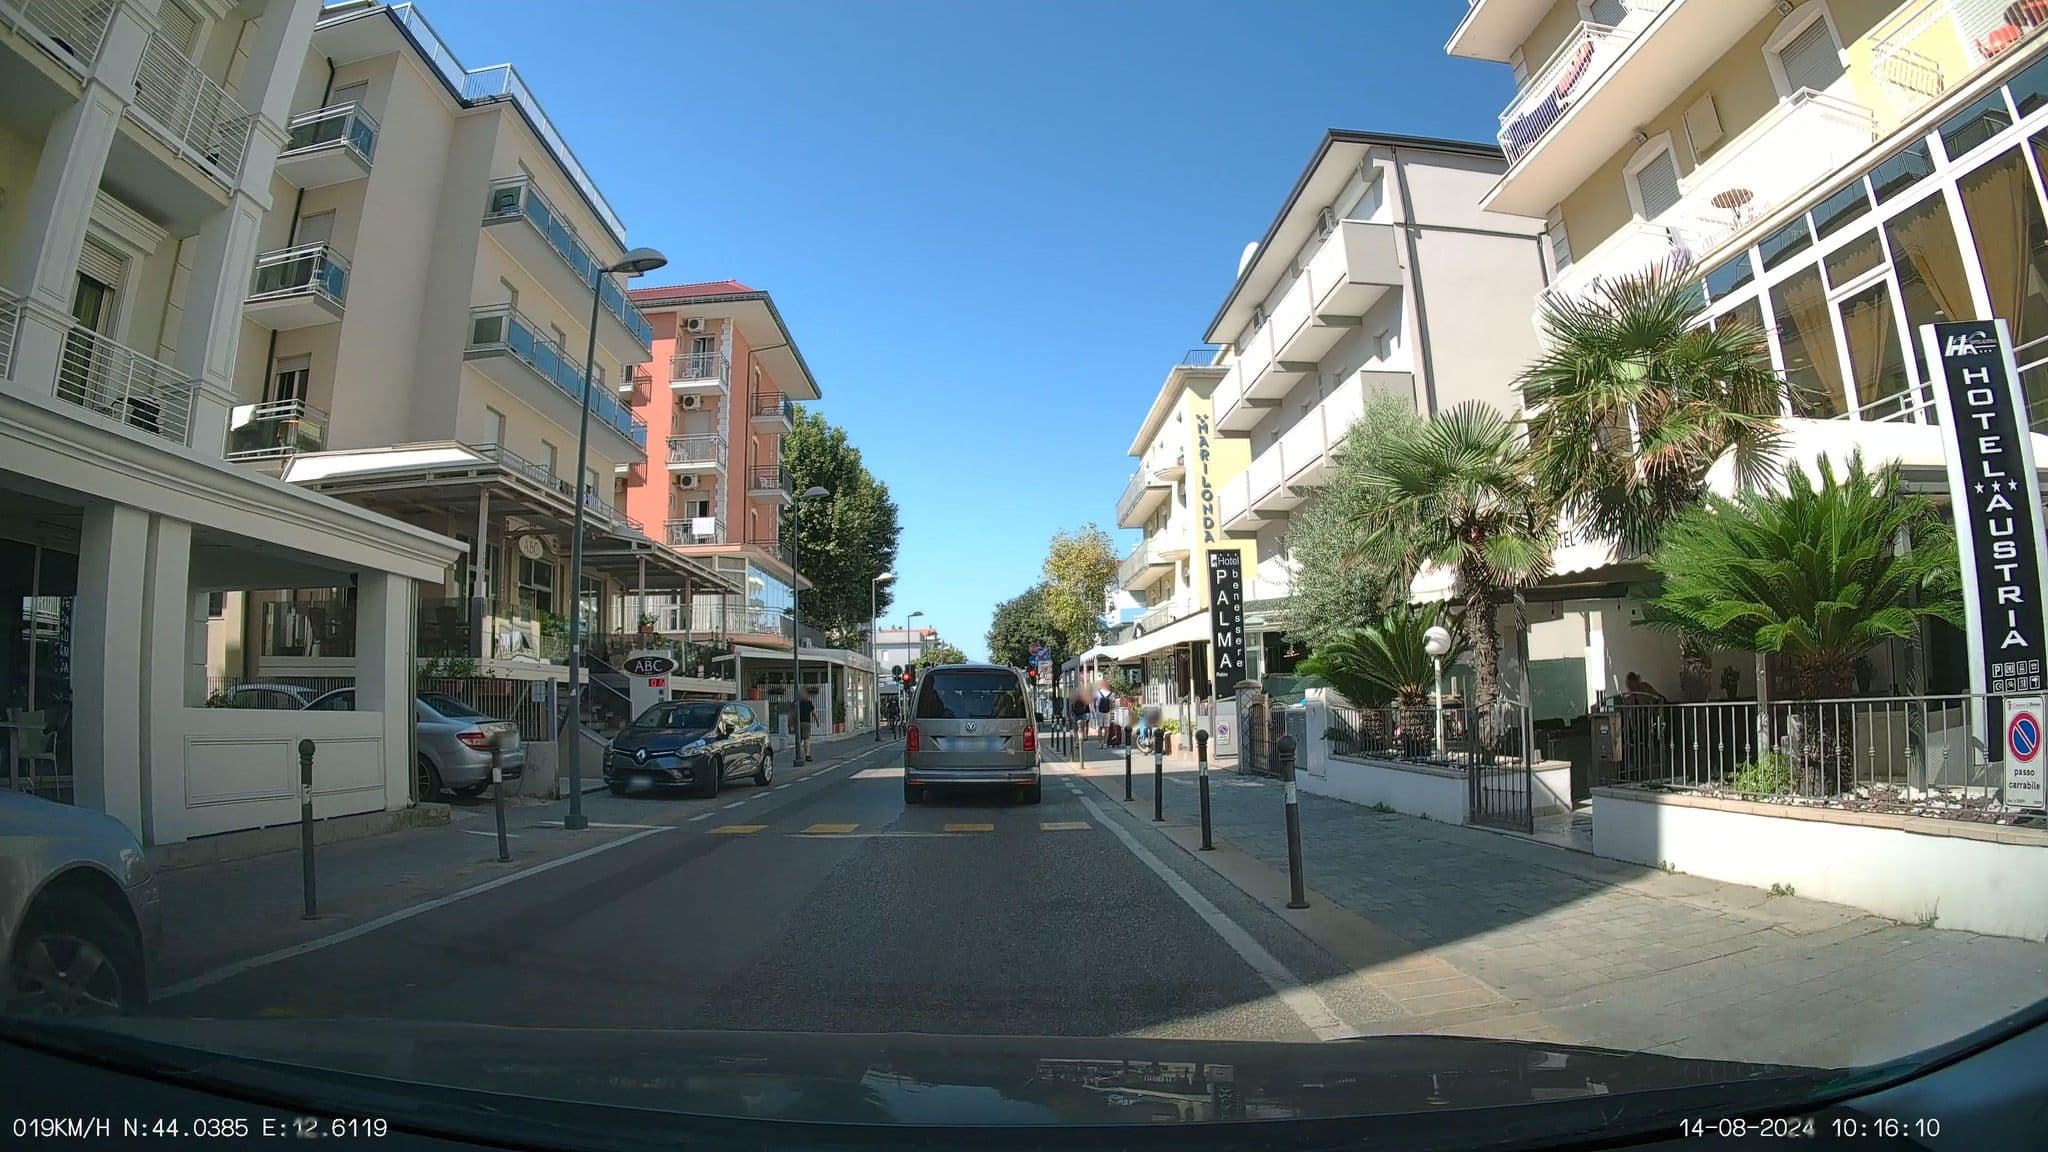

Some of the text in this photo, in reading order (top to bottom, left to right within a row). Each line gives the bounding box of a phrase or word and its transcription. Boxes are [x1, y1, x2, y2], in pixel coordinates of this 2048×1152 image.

[1197, 422, 1215, 544] MARILONDA
[1962, 366, 2006, 478] HOTEL
[1986, 494, 2029, 649] AUSTRIA
[1217, 556, 1240, 566] Hotel
[1216, 569, 1232, 669] PALMA
[1232, 569, 1243, 668] benessere
[634, 659, 663, 673] ABC
[2008, 781, 2041, 790] carrabile
[2014, 768, 2035, 777] passo
